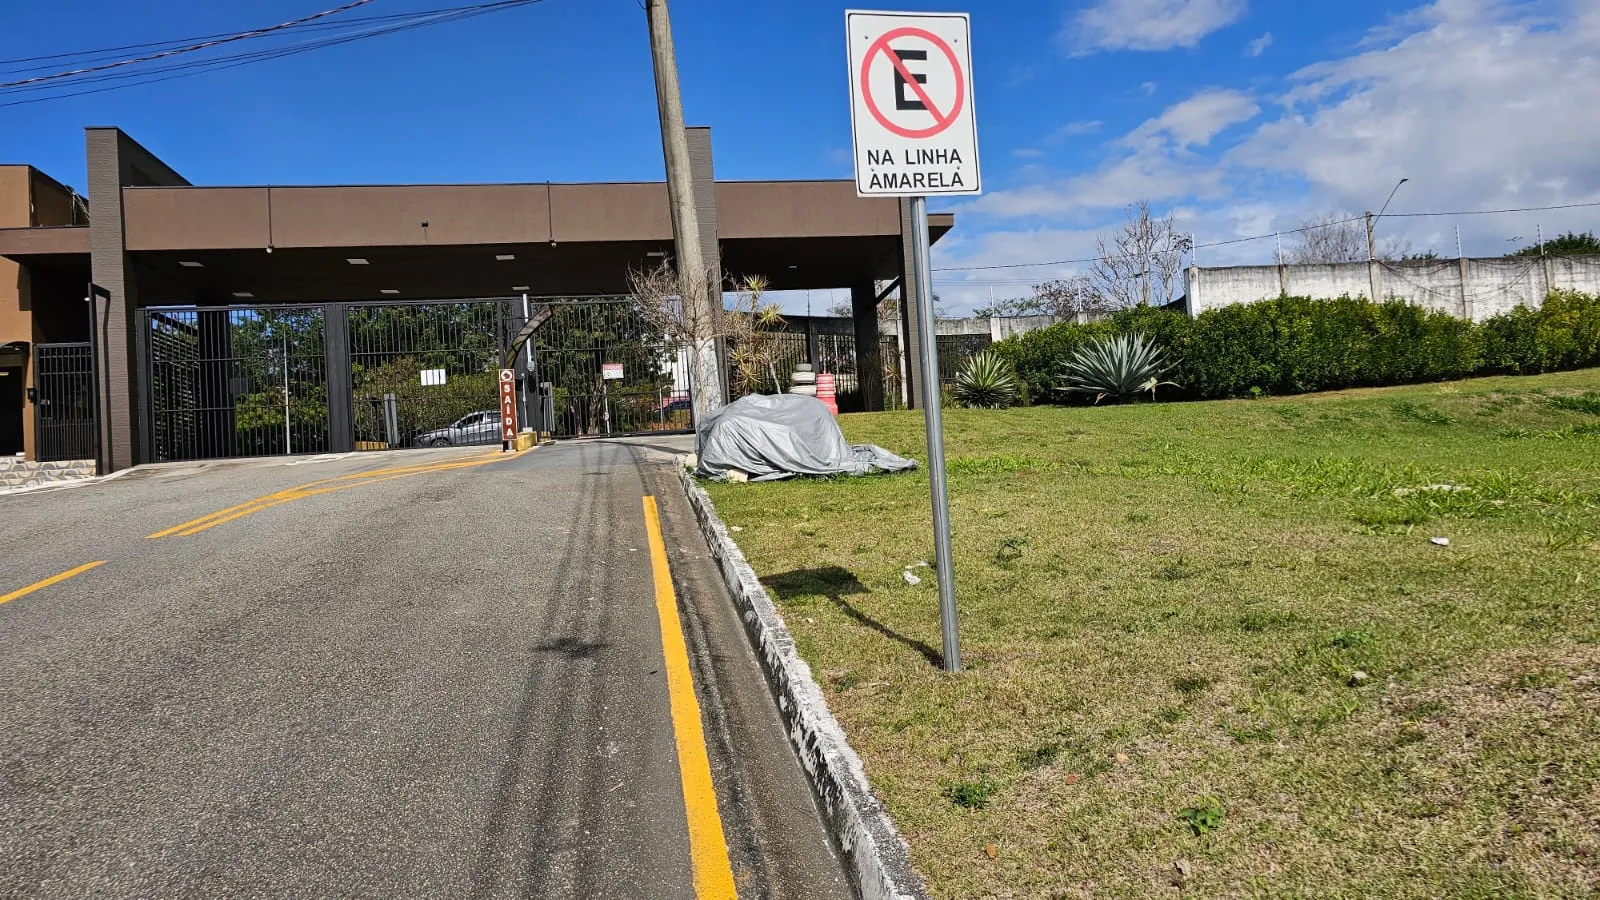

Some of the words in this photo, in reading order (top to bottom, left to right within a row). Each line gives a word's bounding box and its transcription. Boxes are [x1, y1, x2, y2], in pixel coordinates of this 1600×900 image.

[893, 49, 928, 110] E
[867, 149, 895, 166] NA
[905, 148, 962, 165] LINHA
[869, 172, 964, 189] AMARELA
